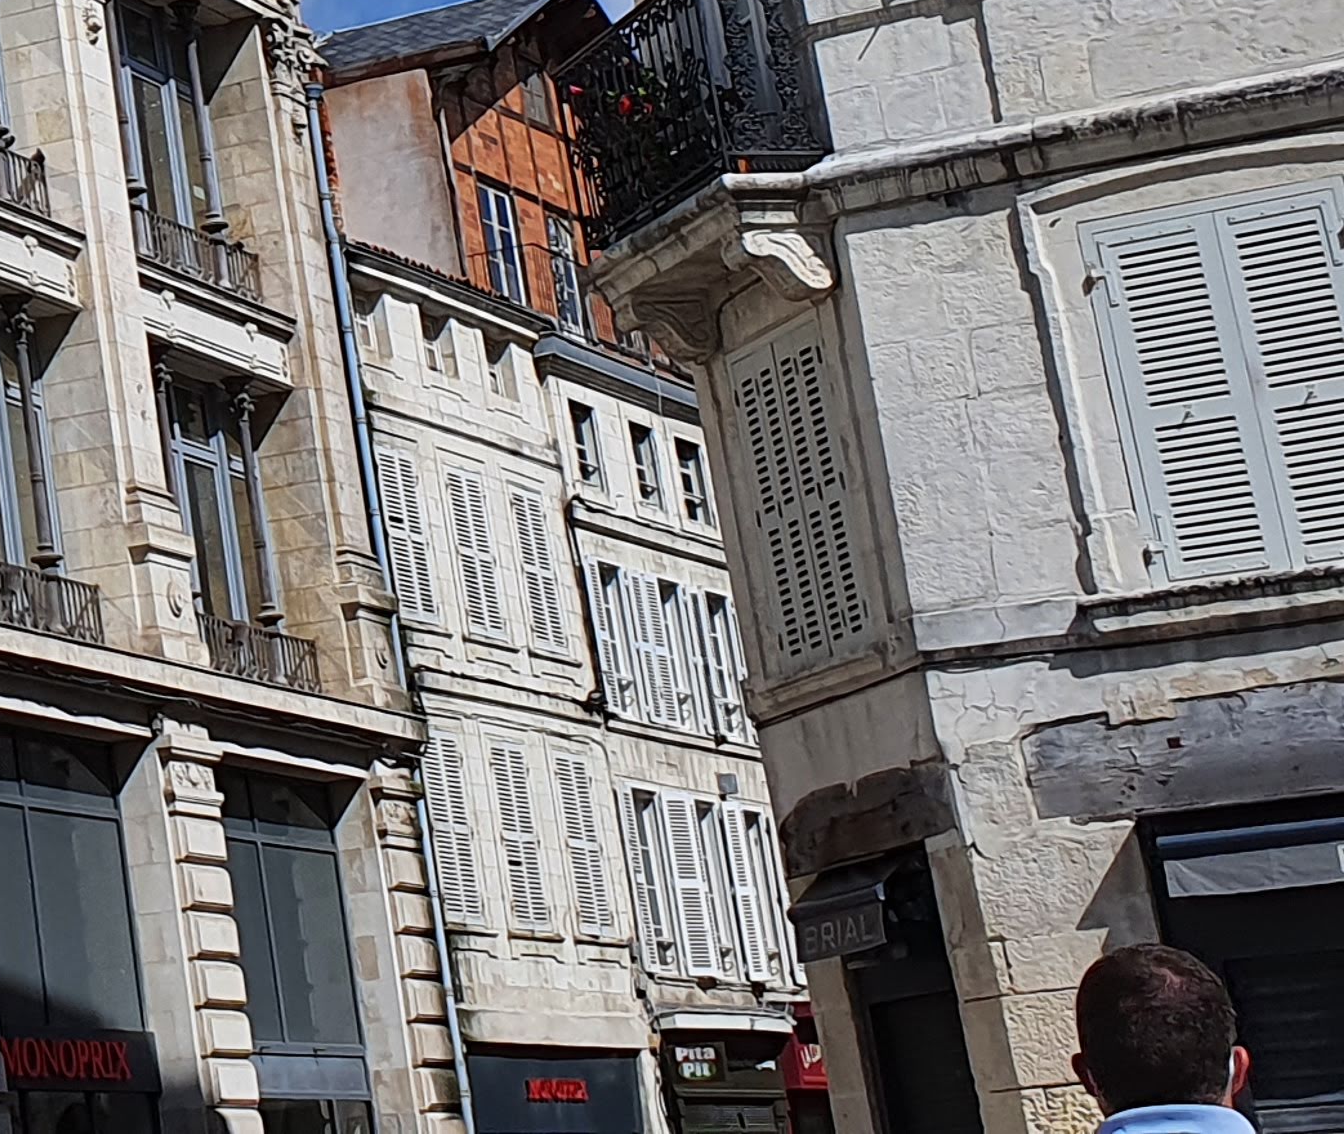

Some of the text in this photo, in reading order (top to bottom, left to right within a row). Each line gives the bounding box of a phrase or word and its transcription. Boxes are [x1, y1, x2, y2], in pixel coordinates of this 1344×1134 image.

[804, 913, 874, 955] BRIAL
[0, 1036, 133, 1081] MONOPRIX
[674, 1046, 716, 1062] Pita
[683, 1062, 711, 1078] Pit
